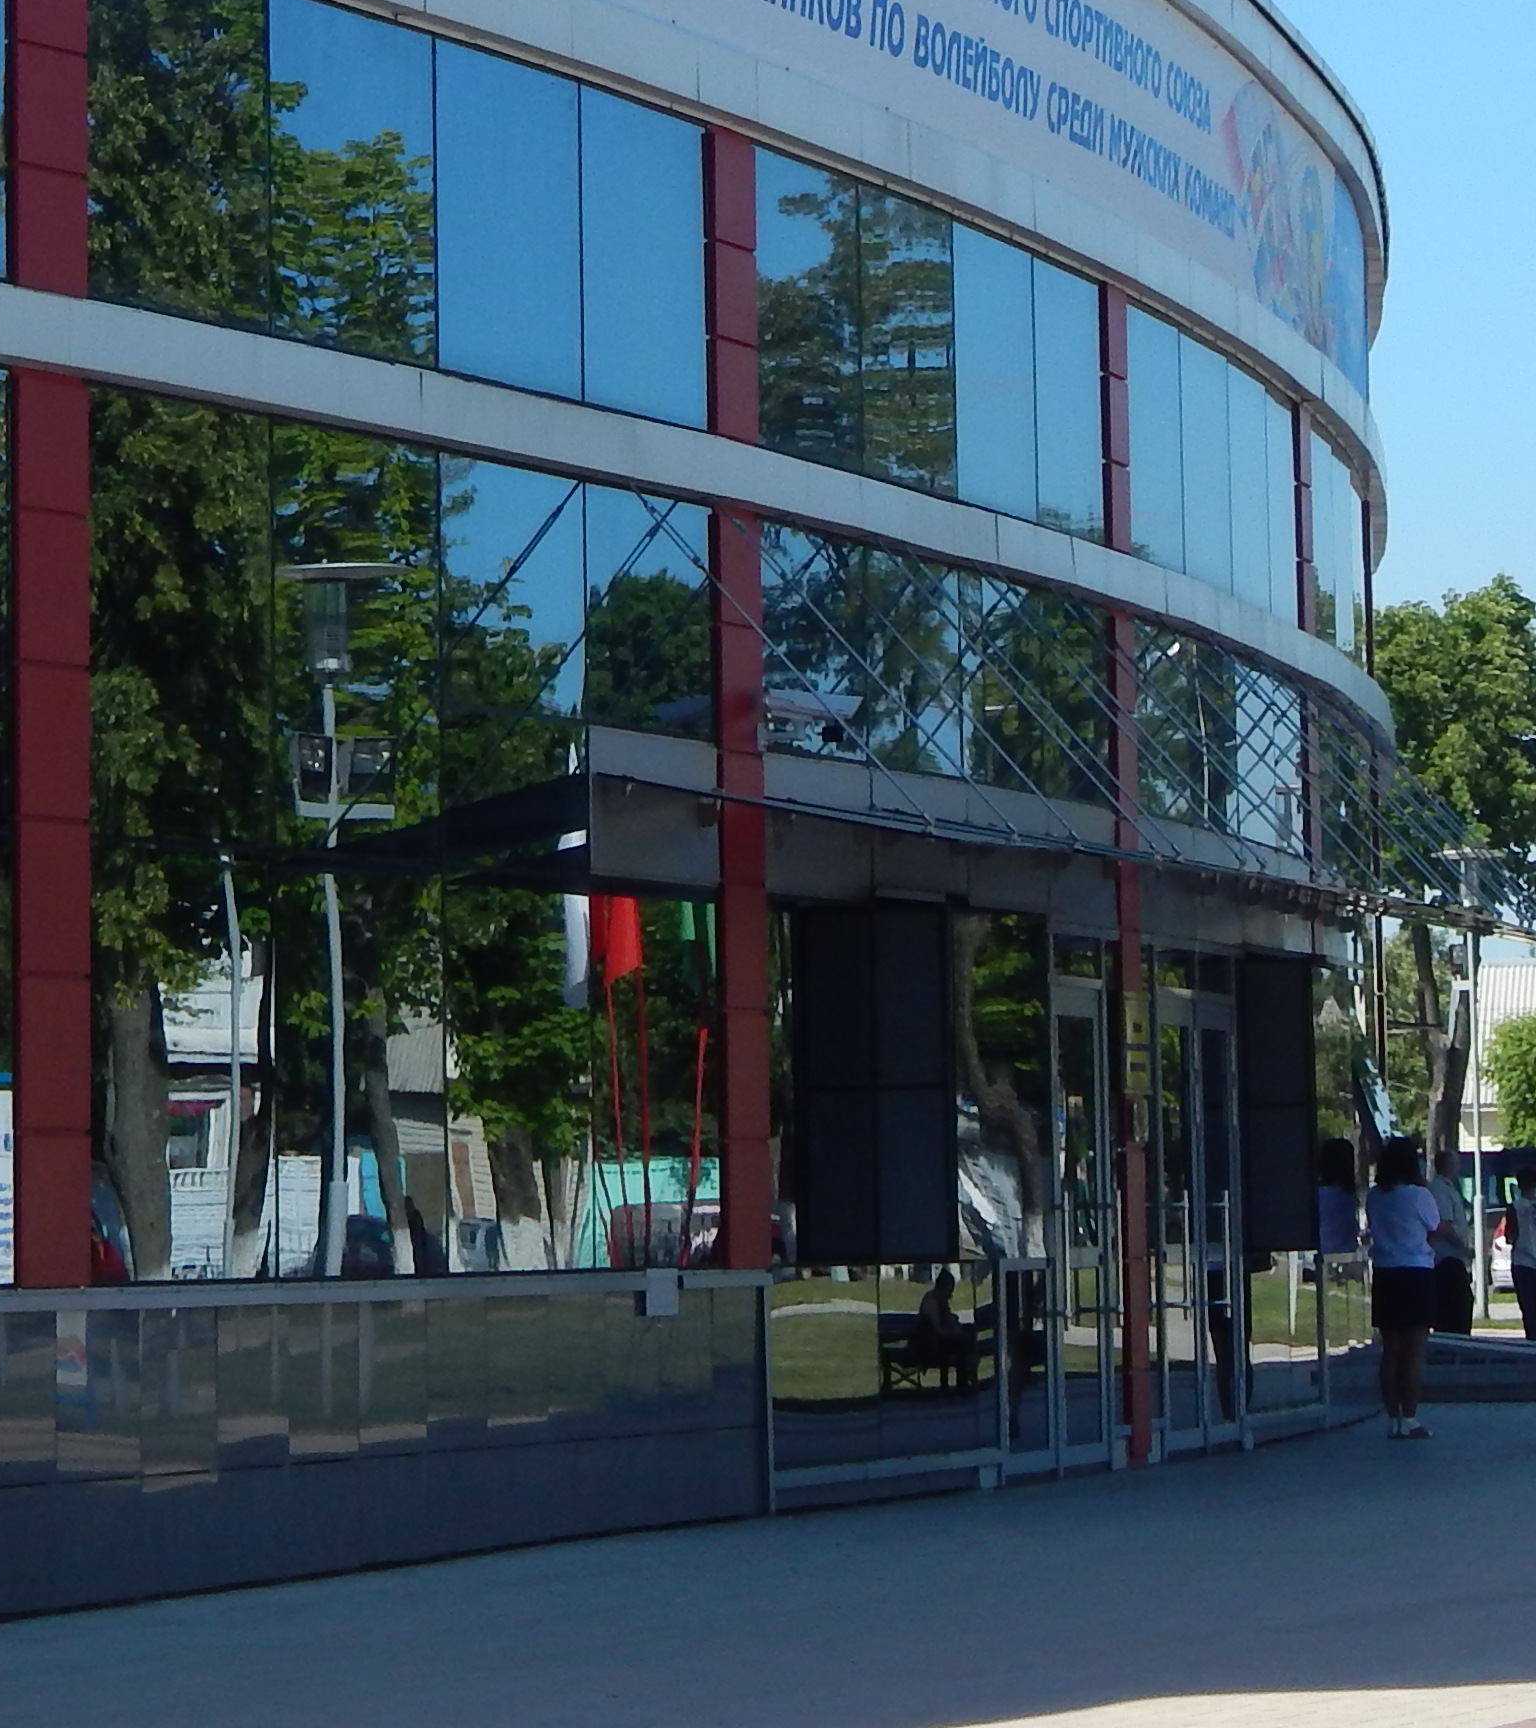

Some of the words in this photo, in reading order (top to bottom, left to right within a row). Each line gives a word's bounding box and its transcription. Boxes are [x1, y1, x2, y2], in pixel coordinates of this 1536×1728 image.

[913, 12, 1042, 121] ВОЛЕЙБОЛУ
[1047, 82, 1105, 156] СРЕДИ
[1109, 114, 1182, 203] МУЖСКИХ
[1184, 162, 1236, 240] КОМАНД
[1166, 61, 1212, 135] СОЮЗА
